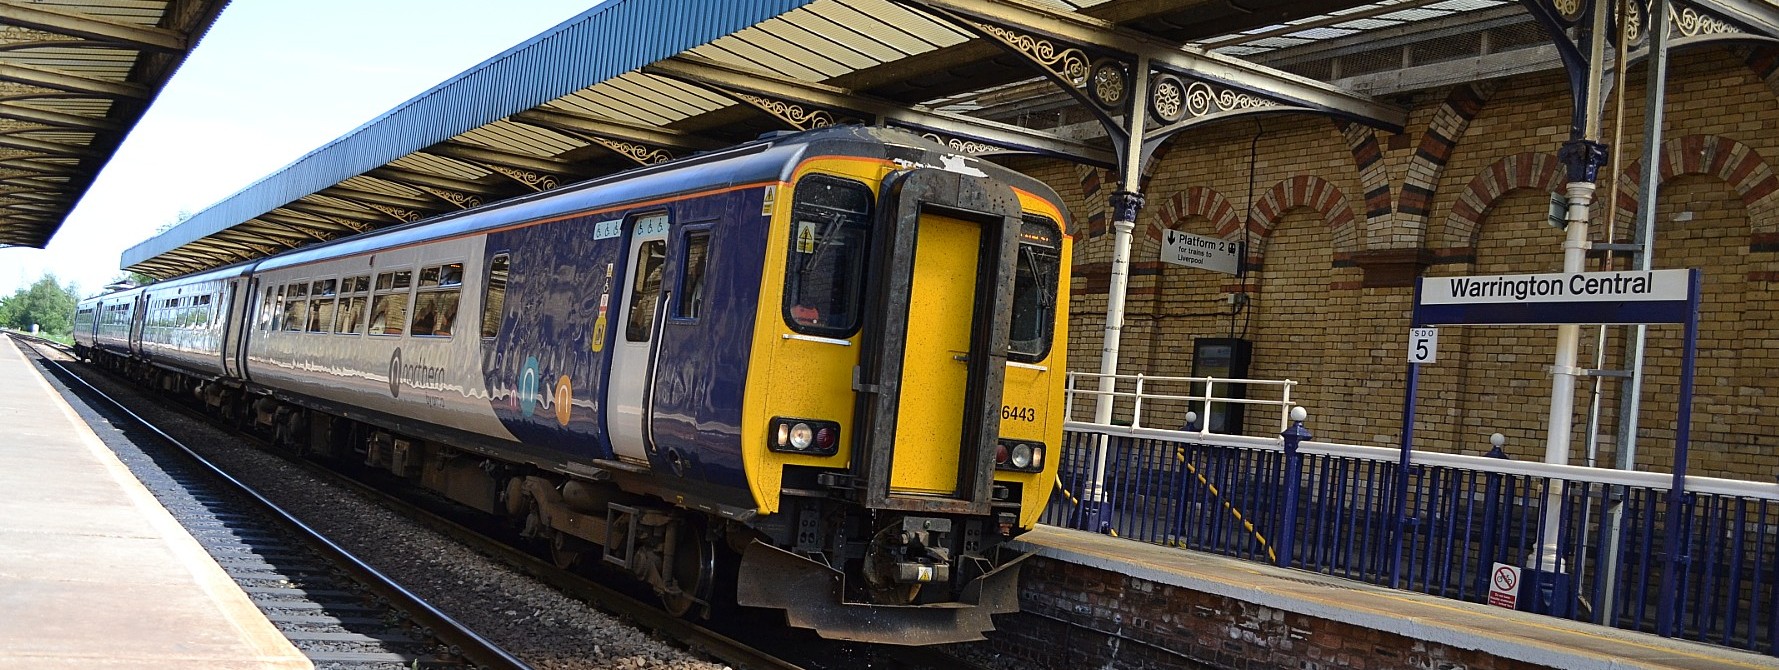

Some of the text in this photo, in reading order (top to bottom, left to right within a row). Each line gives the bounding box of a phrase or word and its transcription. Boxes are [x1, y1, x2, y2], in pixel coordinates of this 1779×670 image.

[1179, 234, 1225, 252] Platform 2
[1177, 254, 1204, 264] Liverpool
[1188, 247, 1205, 258] trains
[1206, 250, 1212, 258] to
[1450, 271, 1653, 300] Warrington Central
[1415, 338, 1428, 360] 5
[403, 357, 445, 388] northern
[1002, 405, 1035, 422] 6443
